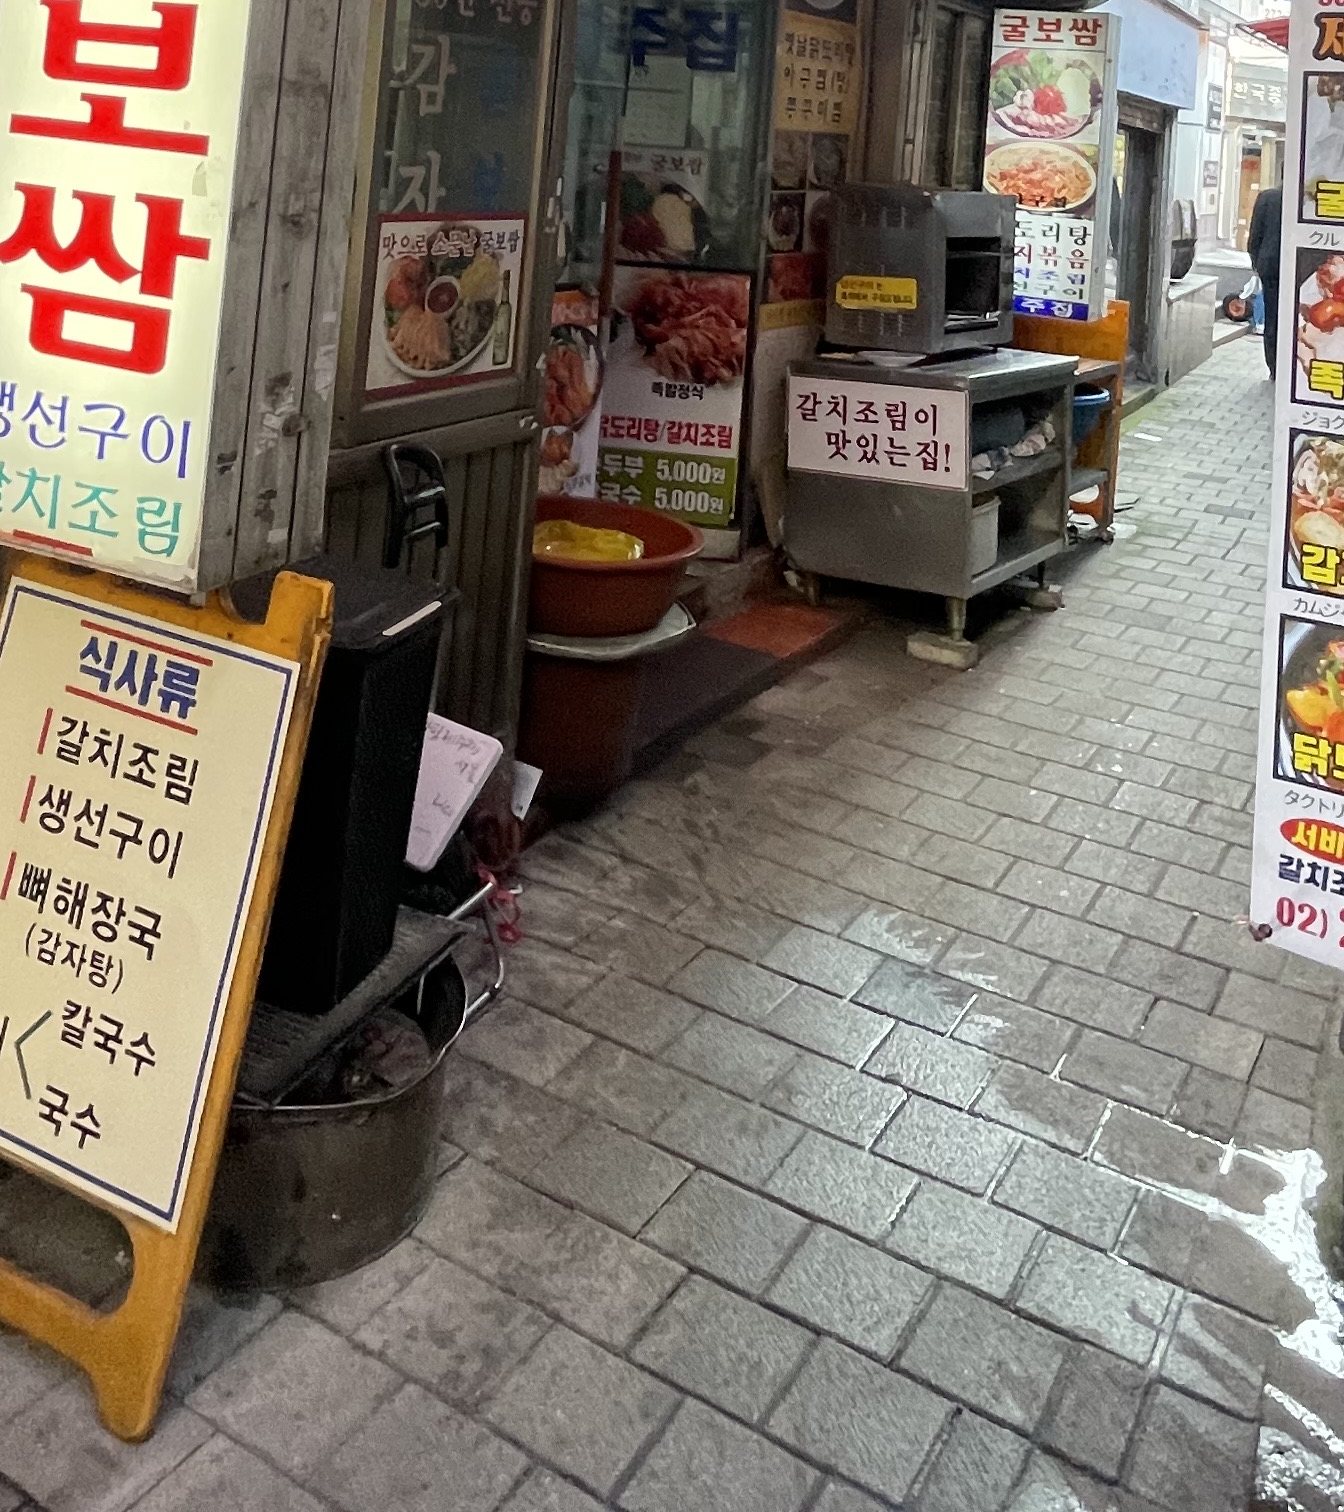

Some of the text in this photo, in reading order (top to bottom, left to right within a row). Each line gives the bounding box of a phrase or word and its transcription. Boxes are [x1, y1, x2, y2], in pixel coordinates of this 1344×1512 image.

[998, 15, 1104, 47] 굴보쌈
[1014, 220, 1092, 247] 도리탕
[1014, 242, 1090, 270] 지볶음
[1020, 298, 1074, 319] 주집
[796, 392, 939, 432] 갈치조림이
[597, 453, 646, 479] 두부
[79, 634, 201, 721] 식사류
[56, 715, 200, 807] 갈치조림
[38, 782, 185, 879] 생선구이
[16, 861, 164, 962] 뼈해장국
[1275, 896, 1329, 939] 02)
[25, 921, 124, 994] (감자탕)
[61, 998, 157, 1078] 칼국수
[38, 1085, 103, 1150] 국수
